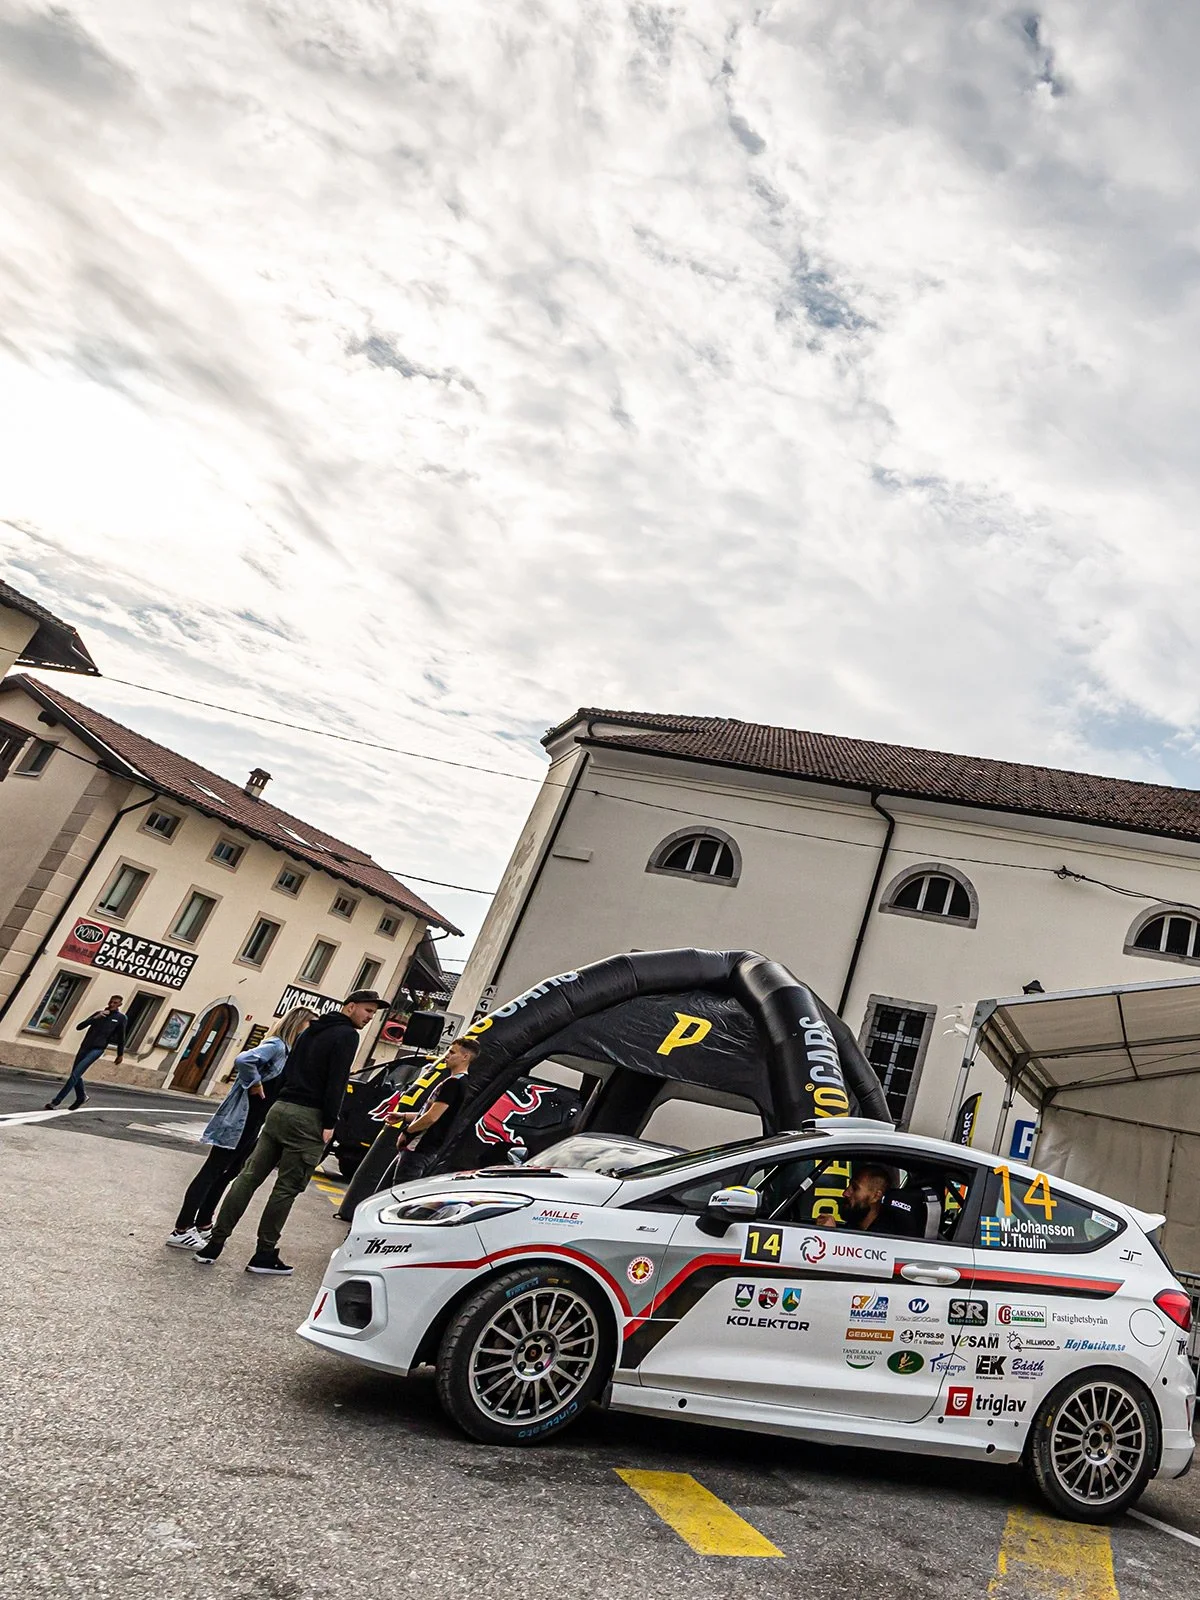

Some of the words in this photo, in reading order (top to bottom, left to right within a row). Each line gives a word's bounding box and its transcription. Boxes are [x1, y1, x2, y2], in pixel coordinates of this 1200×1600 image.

[77, 926, 102, 941] POINT
[105, 931, 194, 967] RAFTING
[99, 943, 188, 978] PARAGLIDING
[95, 955, 182, 987] CANYONING
[656, 1012, 712, 1055] P
[799, 1017, 844, 1087] CARS
[993, 1165, 1058, 1221] 14
[532, 1216, 583, 1226] MOTORSPORT
[541, 1210, 580, 1220] MILLE
[1001, 1217, 1075, 1237] M.Johansson
[749, 1232, 780, 1256] 14
[1001, 1233, 1047, 1250] J.Thulin
[832, 1245, 863, 1259] JUNC
[864, 1249, 887, 1261] CNC
[850, 1310, 887, 1318] HAGMANS
[950, 1301, 985, 1320] SR
[1011, 1309, 1044, 1318] CARLSSON
[726, 1315, 810, 1331] KOLEKTOR
[1052, 1313, 1108, 1326] Fastighetsbyrån
[848, 1331, 891, 1339] GEBWELL
[915, 1330, 945, 1339] Forss.se
[976, 1394, 1027, 1416] triglav
